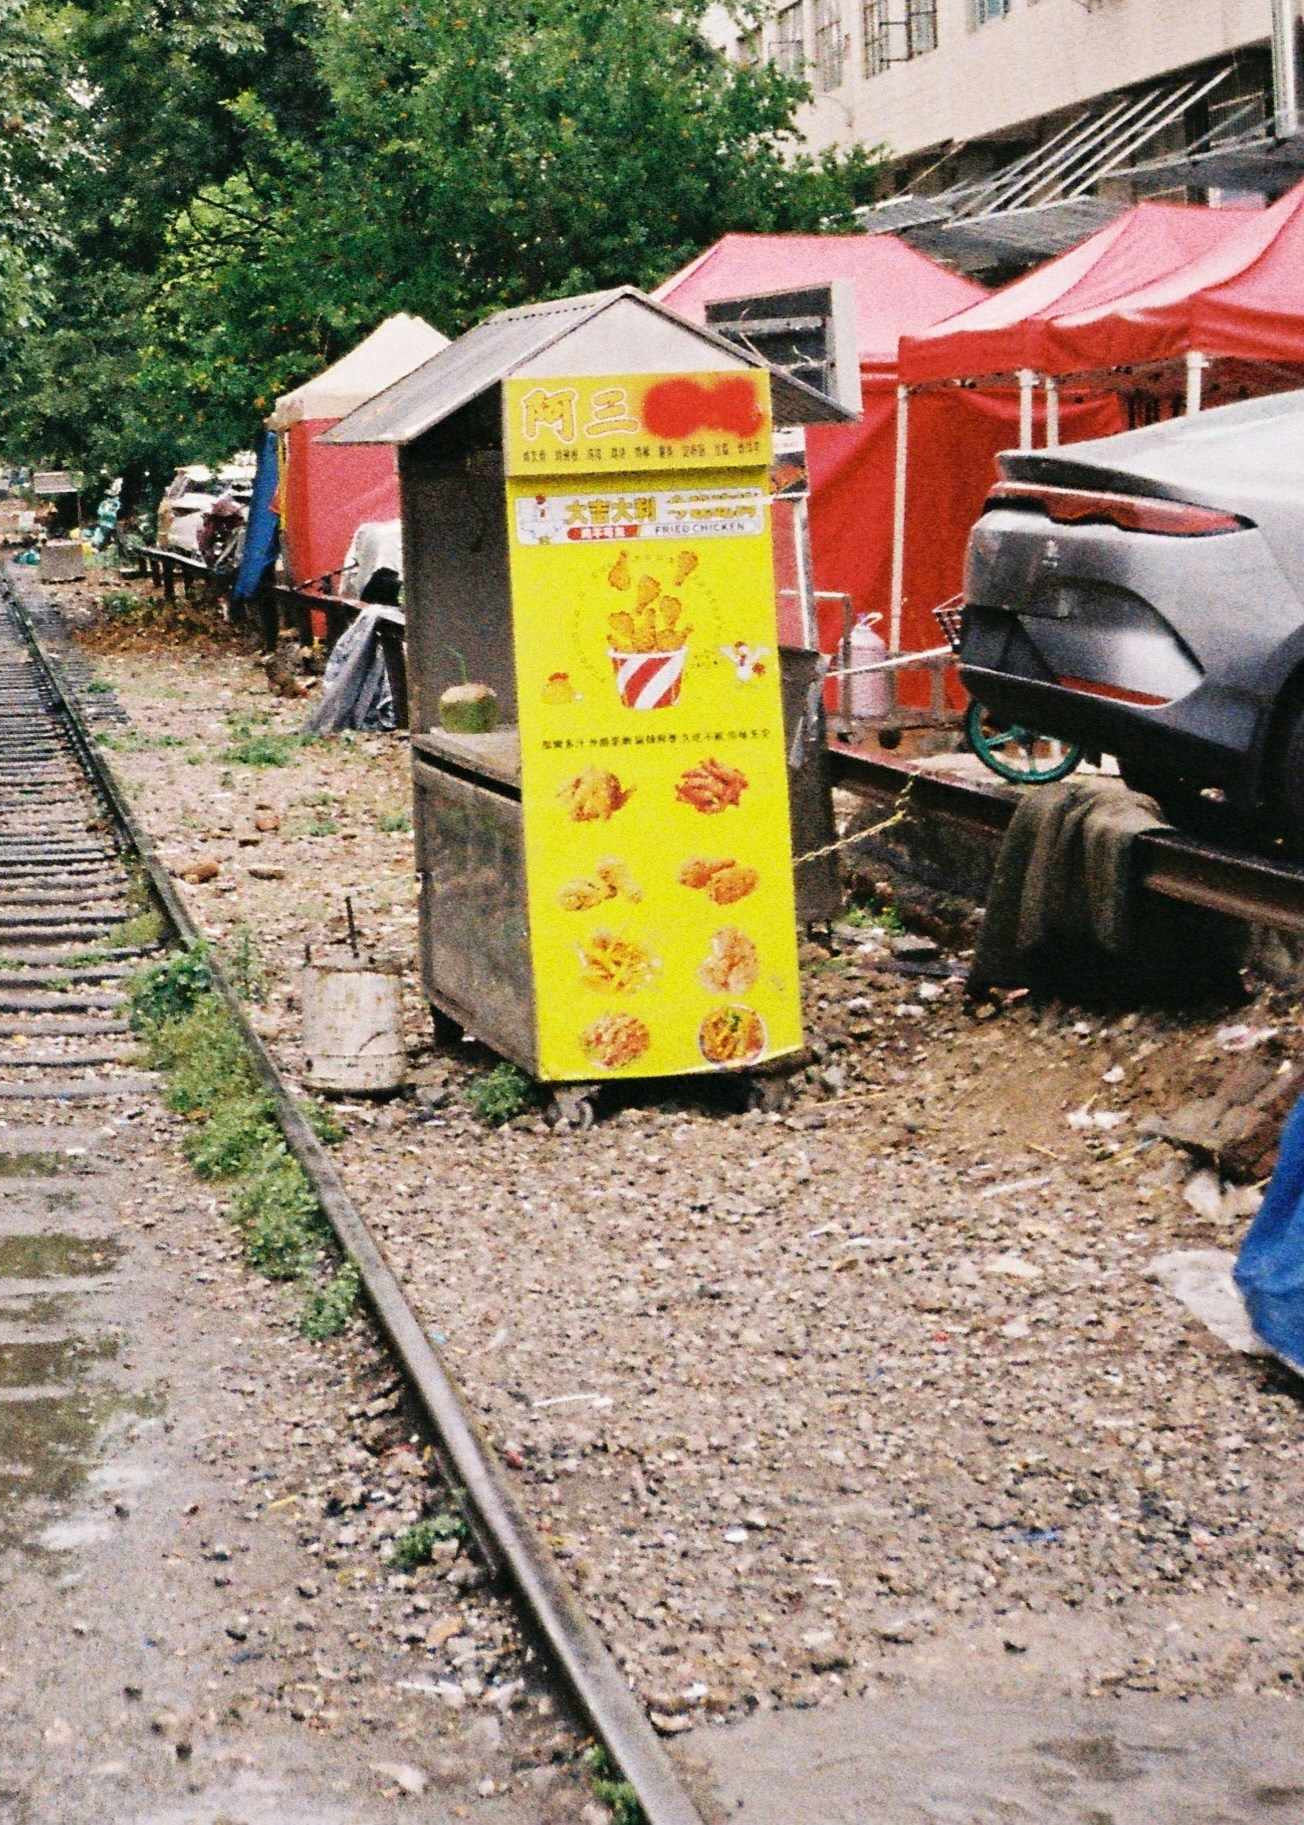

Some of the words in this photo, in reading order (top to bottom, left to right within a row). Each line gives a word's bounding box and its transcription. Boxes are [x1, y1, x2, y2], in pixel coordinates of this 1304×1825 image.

[564, 496, 657, 525] 大吉大利
[655, 524, 689, 535] FRIED
[692, 522, 745, 534] CHICKEN
